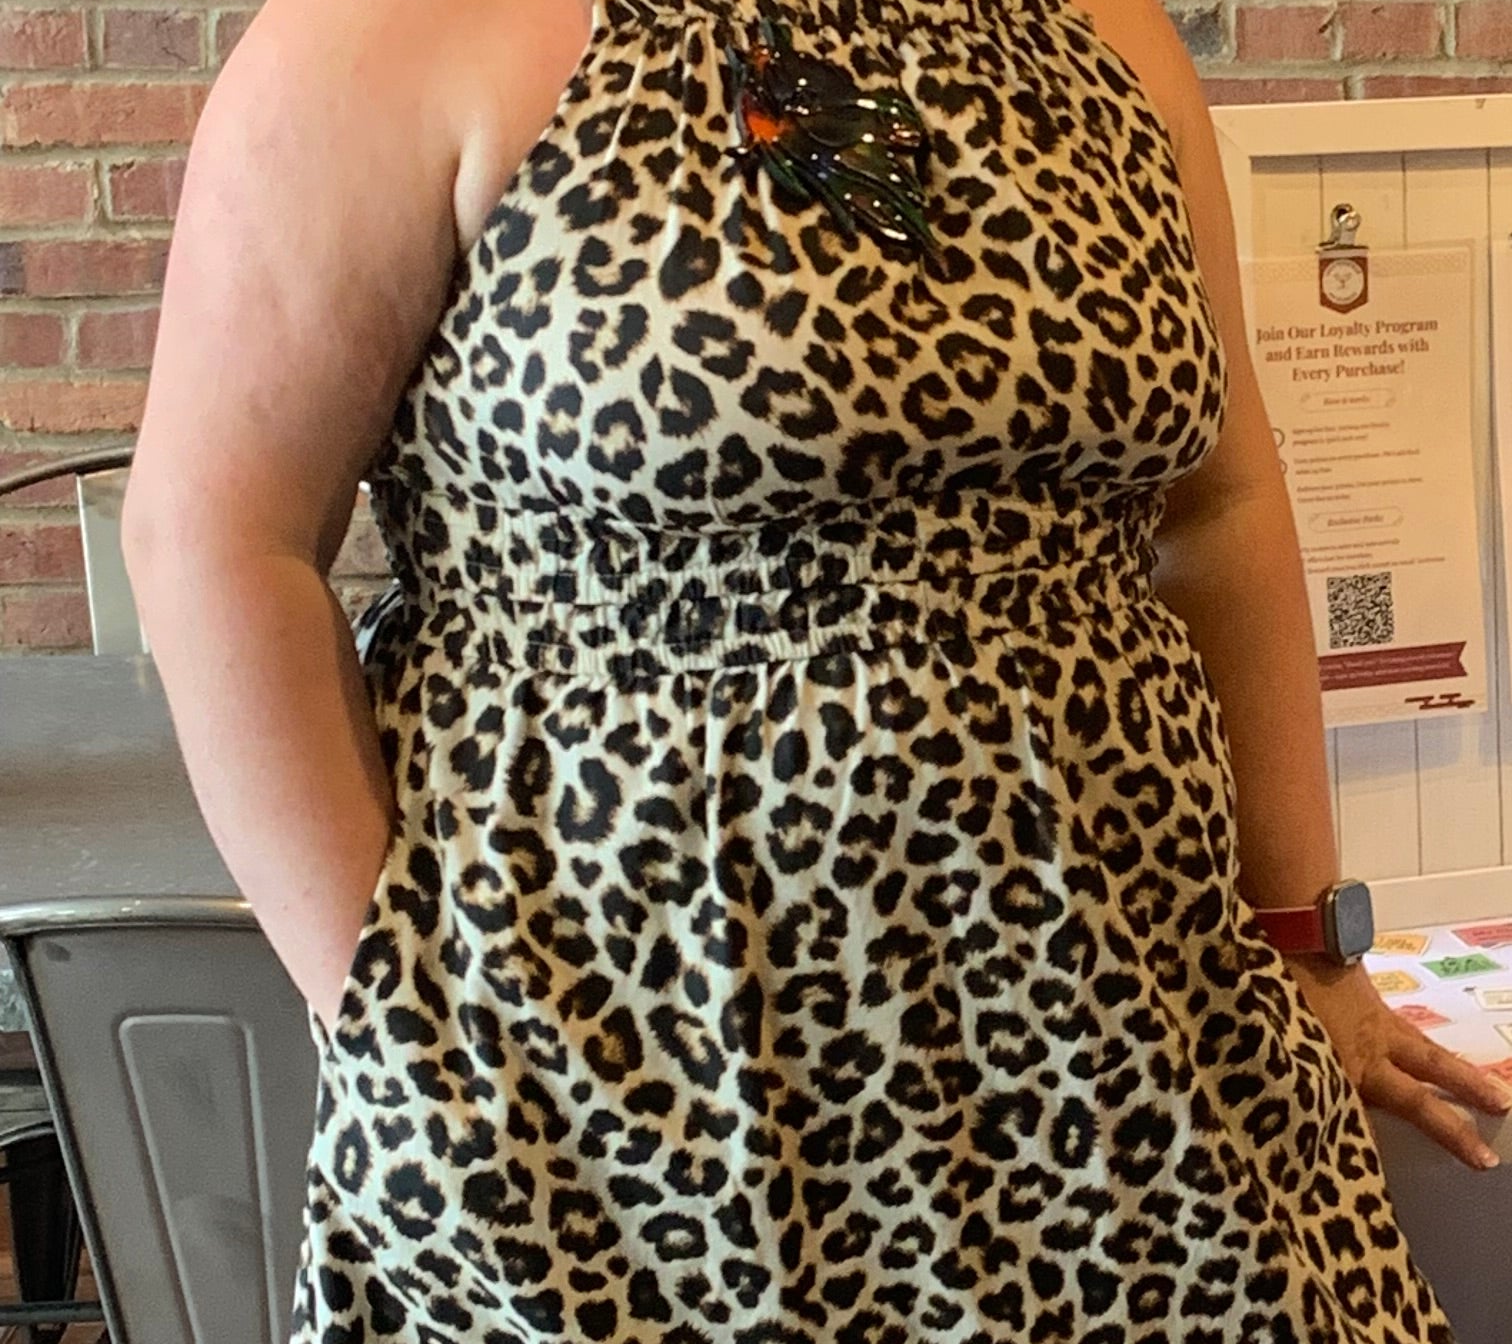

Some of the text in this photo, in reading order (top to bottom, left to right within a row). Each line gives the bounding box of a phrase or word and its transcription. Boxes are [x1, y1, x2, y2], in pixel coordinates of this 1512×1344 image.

[1256, 319, 1438, 345] Join Our Loyalty Program
[1265, 338, 1430, 362] and Earn Rewards with
[1292, 360, 1405, 382] Every Purchase!
